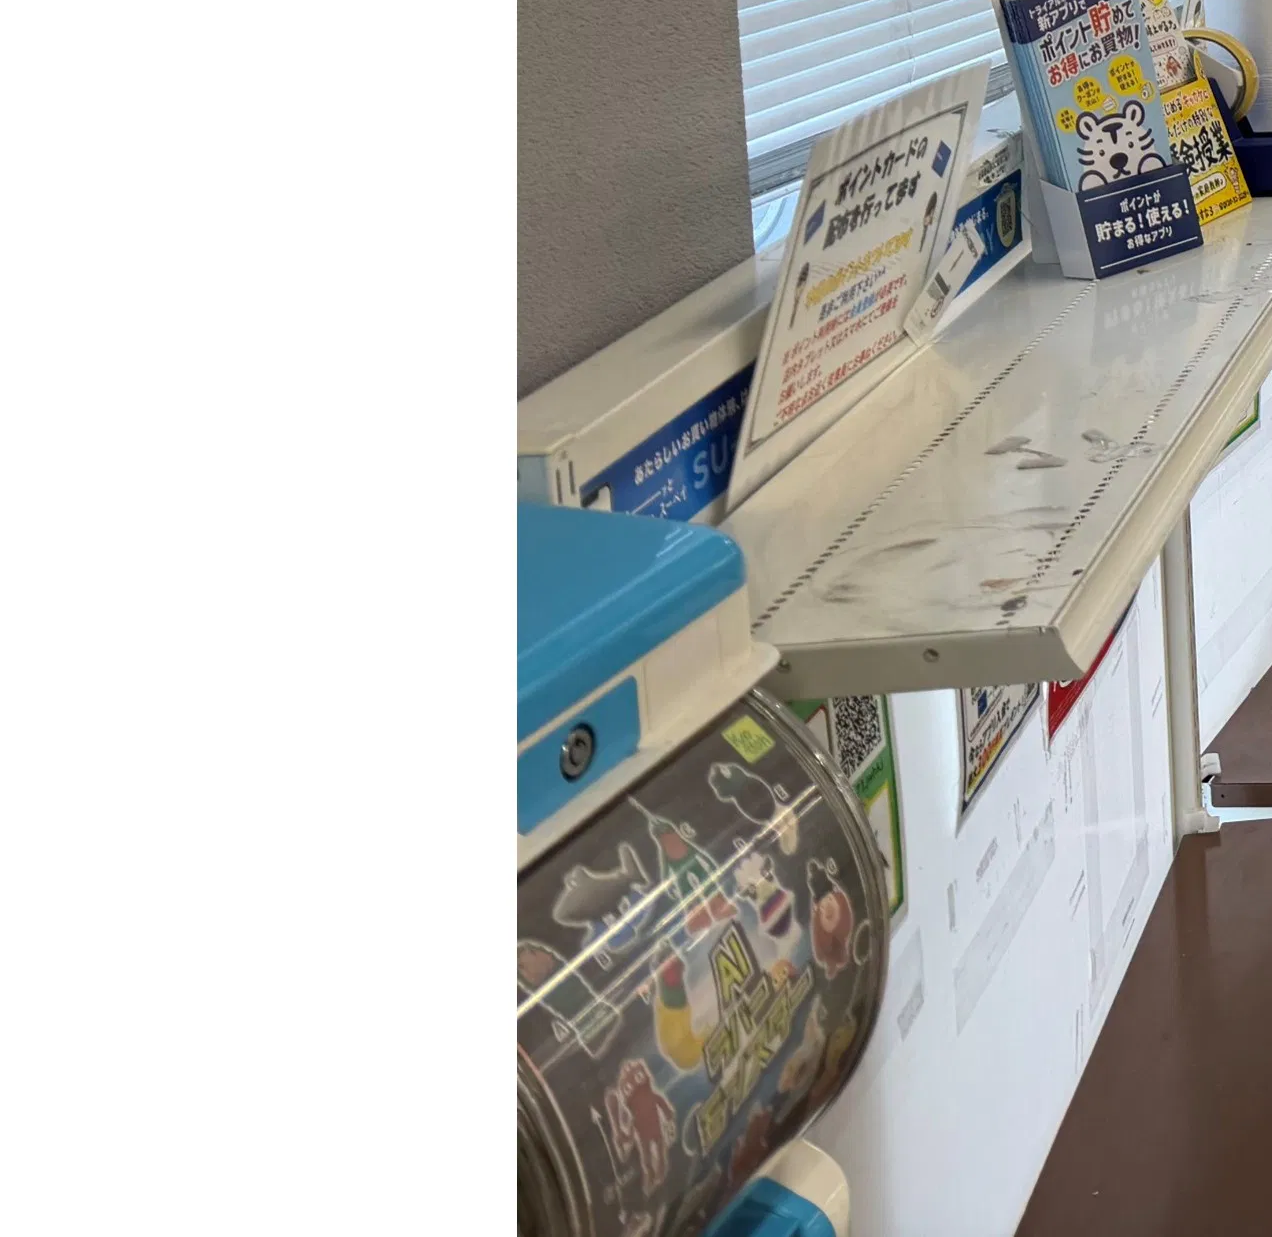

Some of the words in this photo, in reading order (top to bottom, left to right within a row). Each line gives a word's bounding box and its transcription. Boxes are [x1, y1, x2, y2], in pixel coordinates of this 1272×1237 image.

[1039, 0, 1135, 63] ポイント貯めて
[834, 136, 928, 206] ポイントカードの
[1094, 198, 1190, 243] 貯まる！使える！
[1119, 189, 1162, 213] ポイントが
[1126, 225, 1173, 250] お得なアプリ
